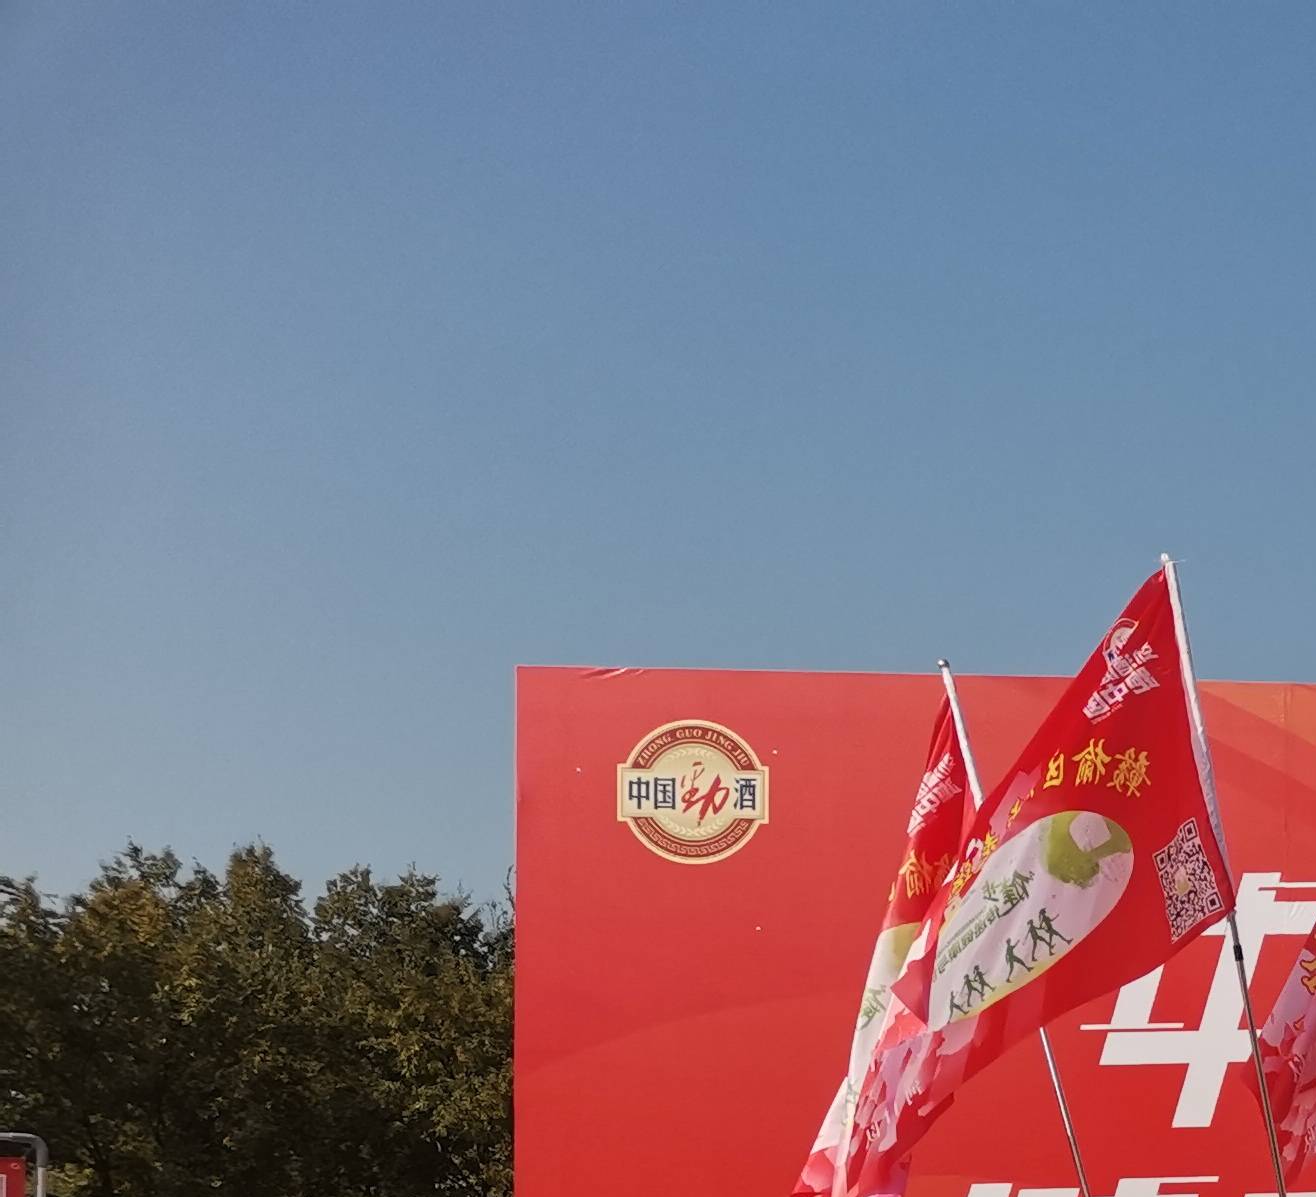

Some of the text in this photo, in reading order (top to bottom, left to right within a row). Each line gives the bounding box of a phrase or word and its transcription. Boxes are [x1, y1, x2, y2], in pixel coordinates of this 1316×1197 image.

[637, 728, 750, 767] ZHONG GUO JING JIU
